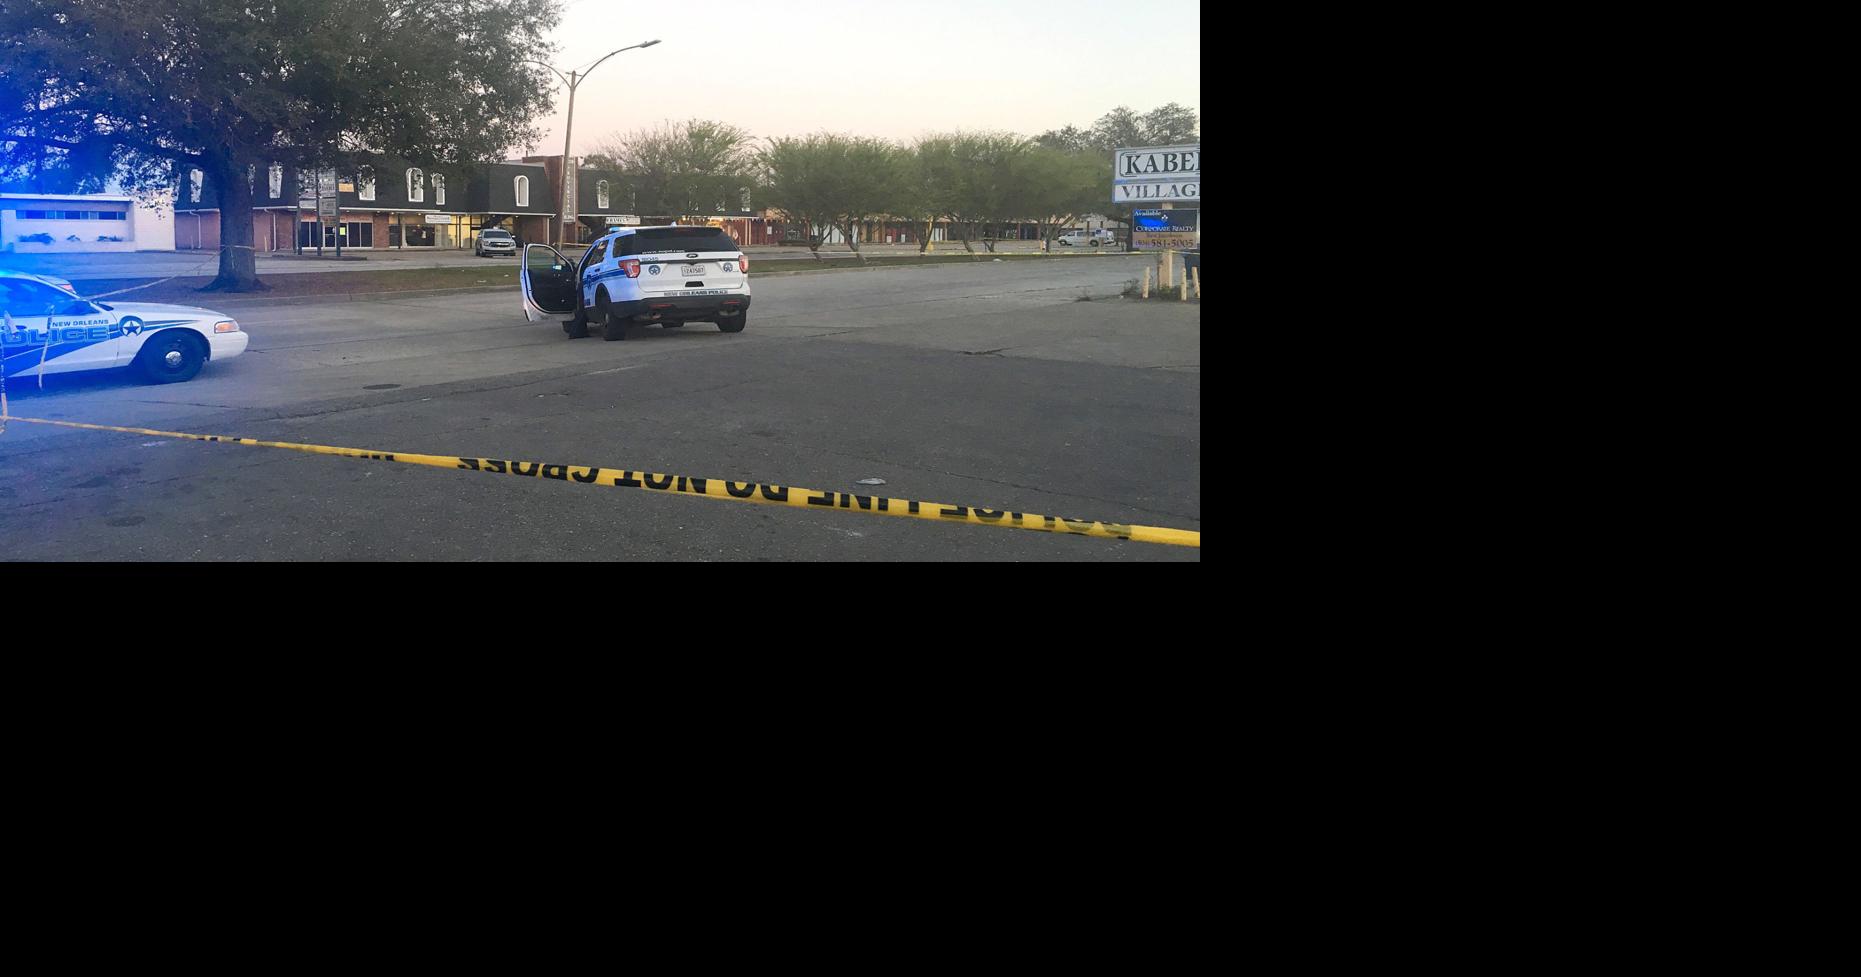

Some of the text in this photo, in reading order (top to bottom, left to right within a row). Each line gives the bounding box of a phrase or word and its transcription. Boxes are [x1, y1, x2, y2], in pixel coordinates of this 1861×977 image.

[1125, 152, 1200, 175] KABE
[1122, 184, 1200, 199] VILLAG
[1134, 209, 1161, 217] Available
